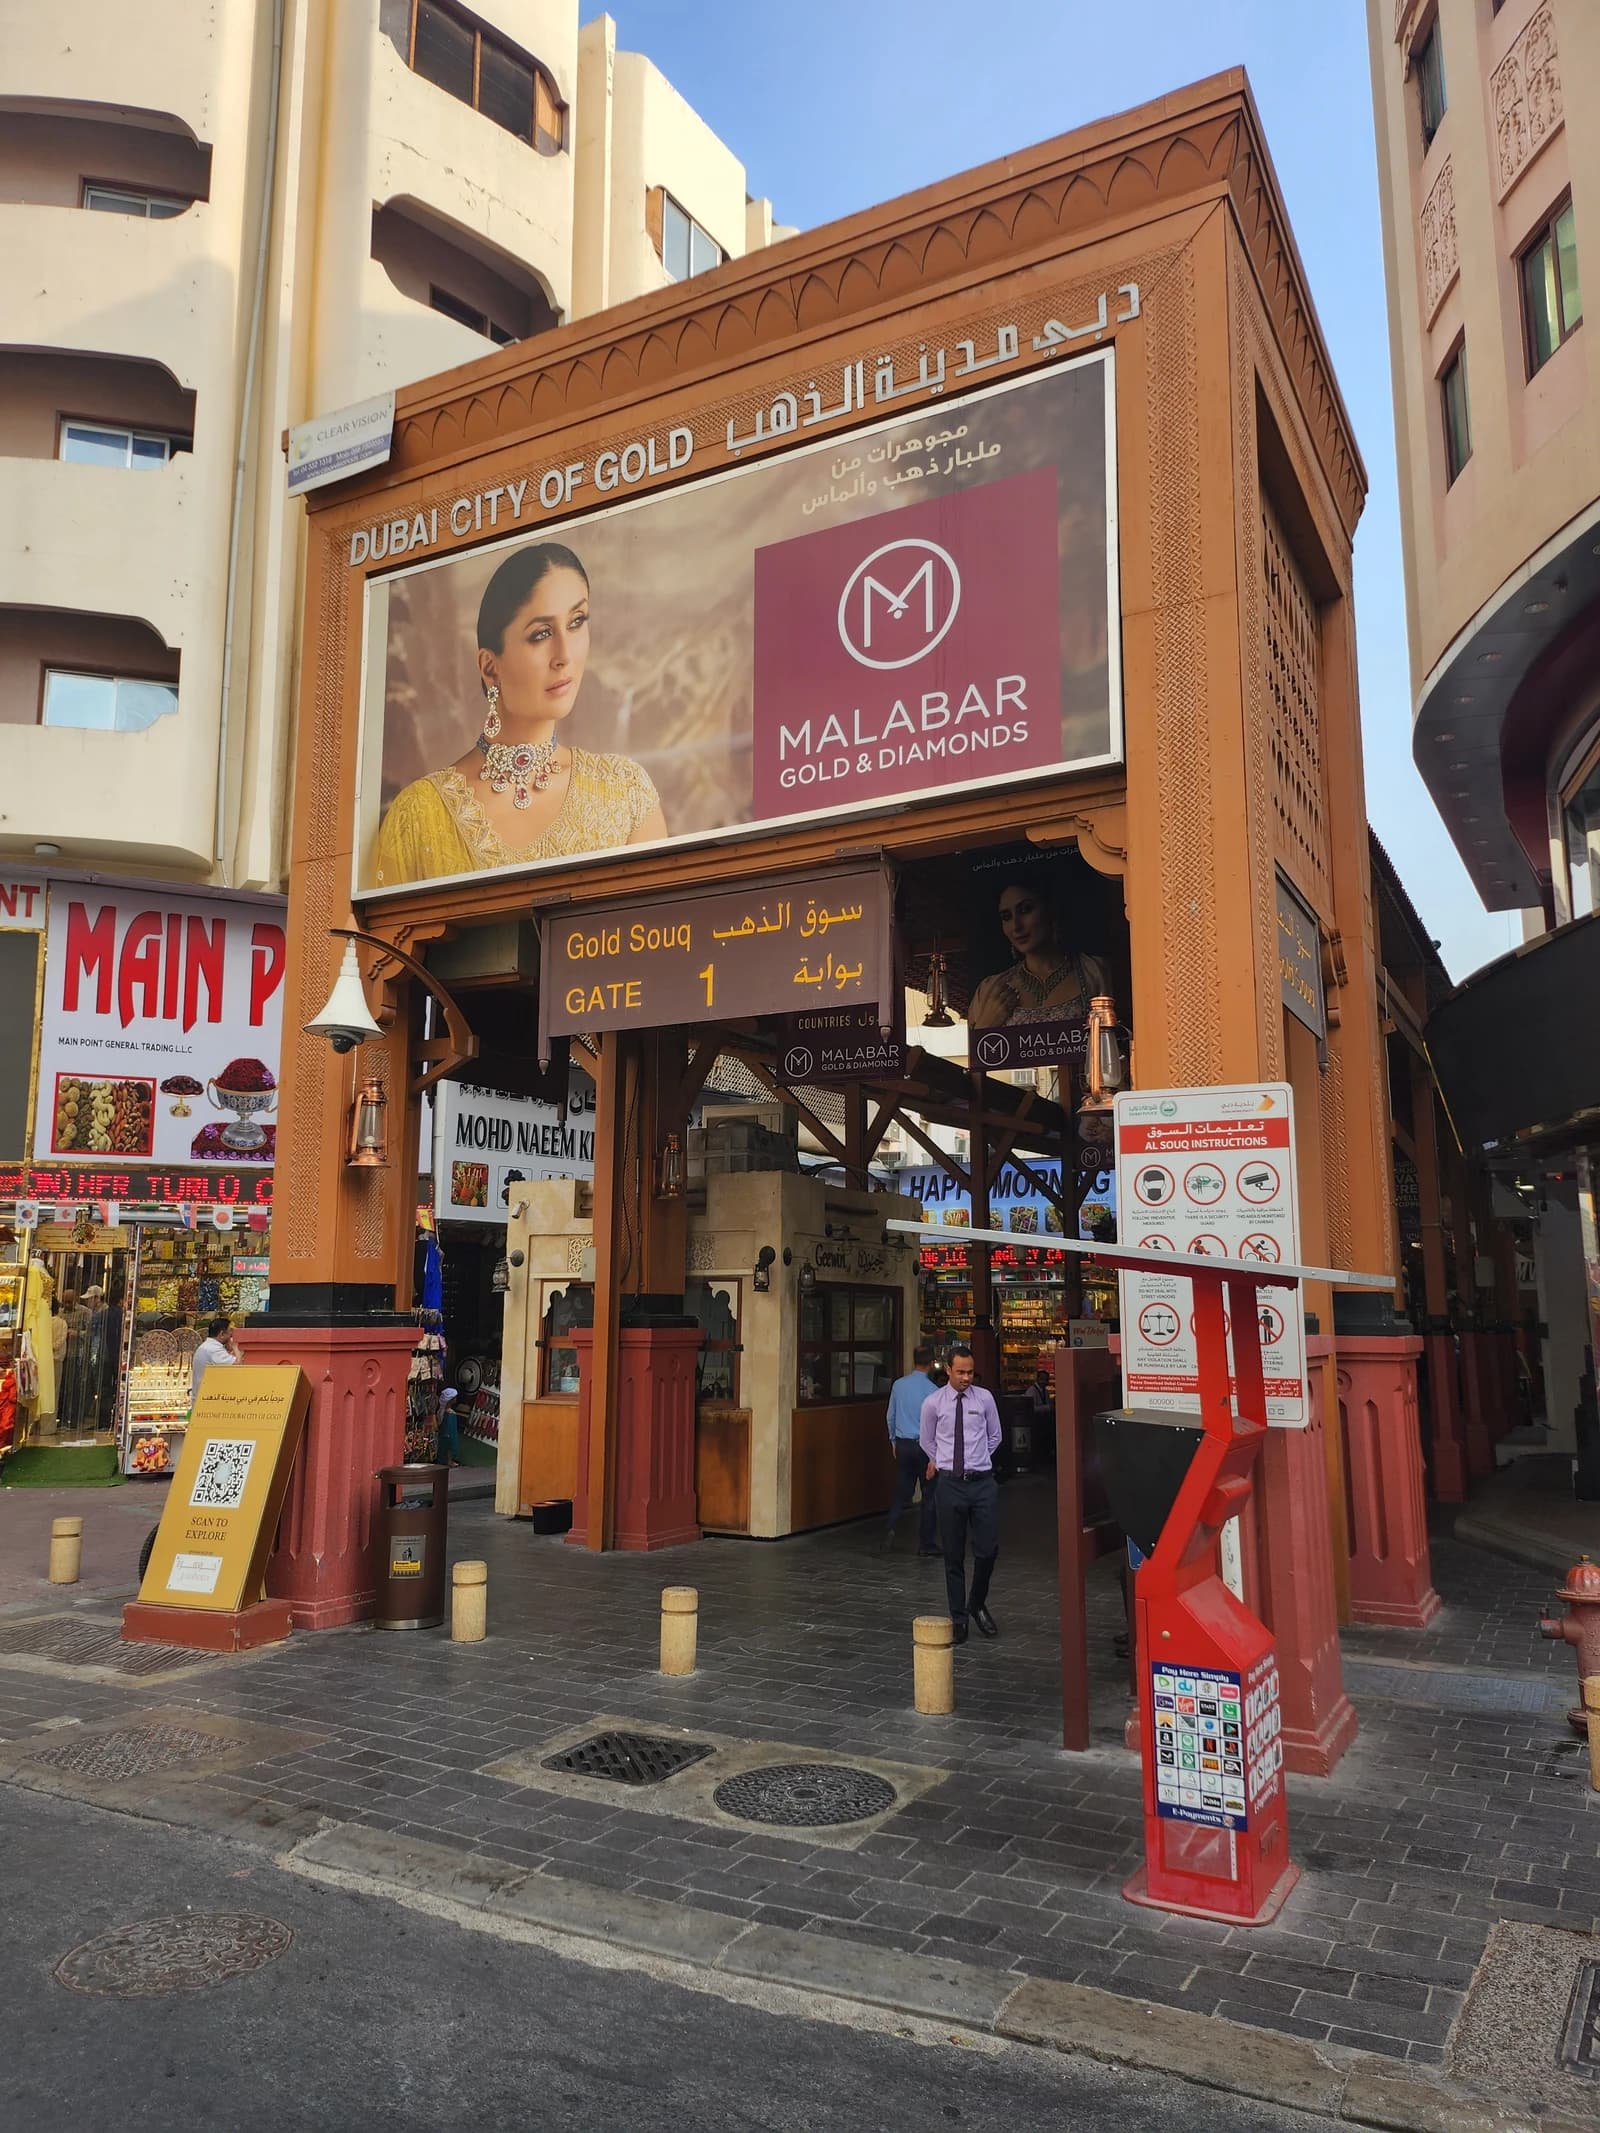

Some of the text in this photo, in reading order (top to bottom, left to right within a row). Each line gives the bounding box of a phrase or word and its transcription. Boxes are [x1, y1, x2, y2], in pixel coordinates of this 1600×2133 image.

[726, 282, 1141, 456] دبي مدينة الذهب
[317, 410, 388, 442] CLEAR VISION
[831, 425, 969, 480] مجوهرات من
[945, 442, 1002, 477] ملبار
[884, 459, 939, 489] ذهب
[350, 427, 695, 567] DUBAI CITY OF GOLD
[779, 674, 1028, 761] MALABAR
[780, 721, 1029, 788] GOLD & DIAMONDS
[712, 900, 864, 946] سوق الذهب
[567, 923, 691, 960] Gold Souq
[62, 901, 228, 1034] MAIN
[793, 952, 864, 991] بوابة
[566, 963, 715, 1015] GATE 1
[798, 1015, 851, 1030] COUNTRIES
[58, 1036, 78, 1046] MAIN
[80, 1038, 103, 1048] POINT
[105, 1040, 139, 1050] GENERAL
[141, 1042, 174, 1053] TRADING
[821, 1045, 900, 1063] MALABAR
[1018, 1030, 1090, 1049] MALABA
[1019, 1048, 1047, 1058] GOLD
[1056, 1045, 1088, 1054] DIAMO
[821, 1062, 845, 1071] GOLD
[853, 1059, 900, 1069] DIAMONDS
[456, 1112, 513, 1151] MOHD
[516, 1120, 575, 1159] NAEEM
[1145, 1136, 1268, 1151] AL SOUQ INSTRUCTIONS
[1147, 1119, 1264, 1139] تعليمات السوق
[185, 1529, 227, 1541] EXPLORE
[191, 1516, 229, 1527] SCAN TO
[1162, 1666, 1229, 1683] Pay Here Simply
[1172, 1808, 1222, 1822] E-Payments
